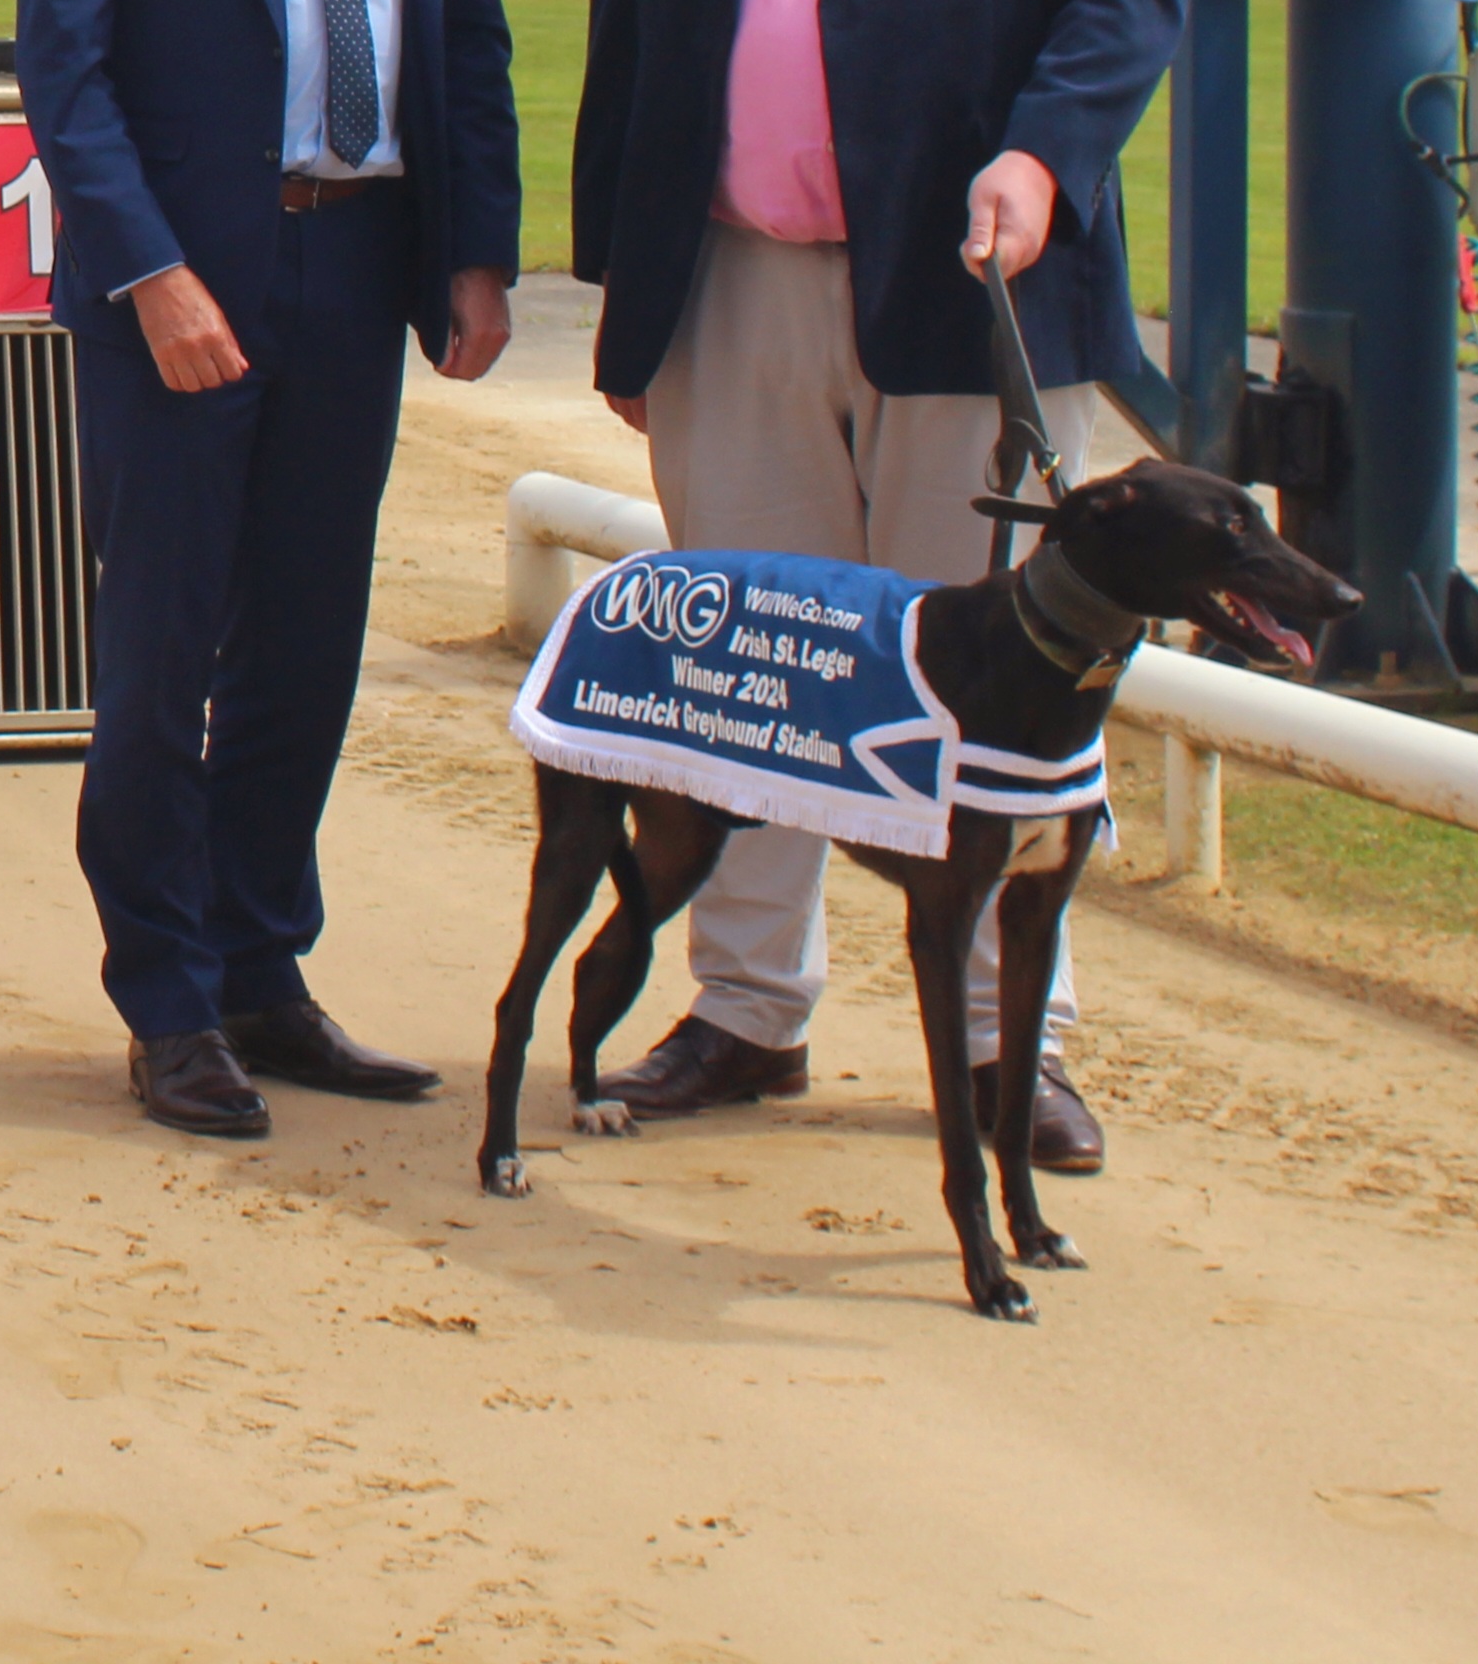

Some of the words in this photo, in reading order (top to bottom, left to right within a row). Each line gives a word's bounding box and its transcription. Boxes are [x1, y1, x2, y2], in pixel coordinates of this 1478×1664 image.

[603, 572, 723, 638] WWG
[744, 585, 864, 632] WillWeGo.com
[671, 654, 736, 697] Winner
[735, 671, 788, 710] 2024
[728, 624, 771, 662] Irish
[772, 633, 798, 667] St.
[800, 638, 856, 682] Leger
[573, 679, 682, 729] Limerick
[681, 700, 776, 752] Greyhound
[773, 721, 842, 769] Stadium
